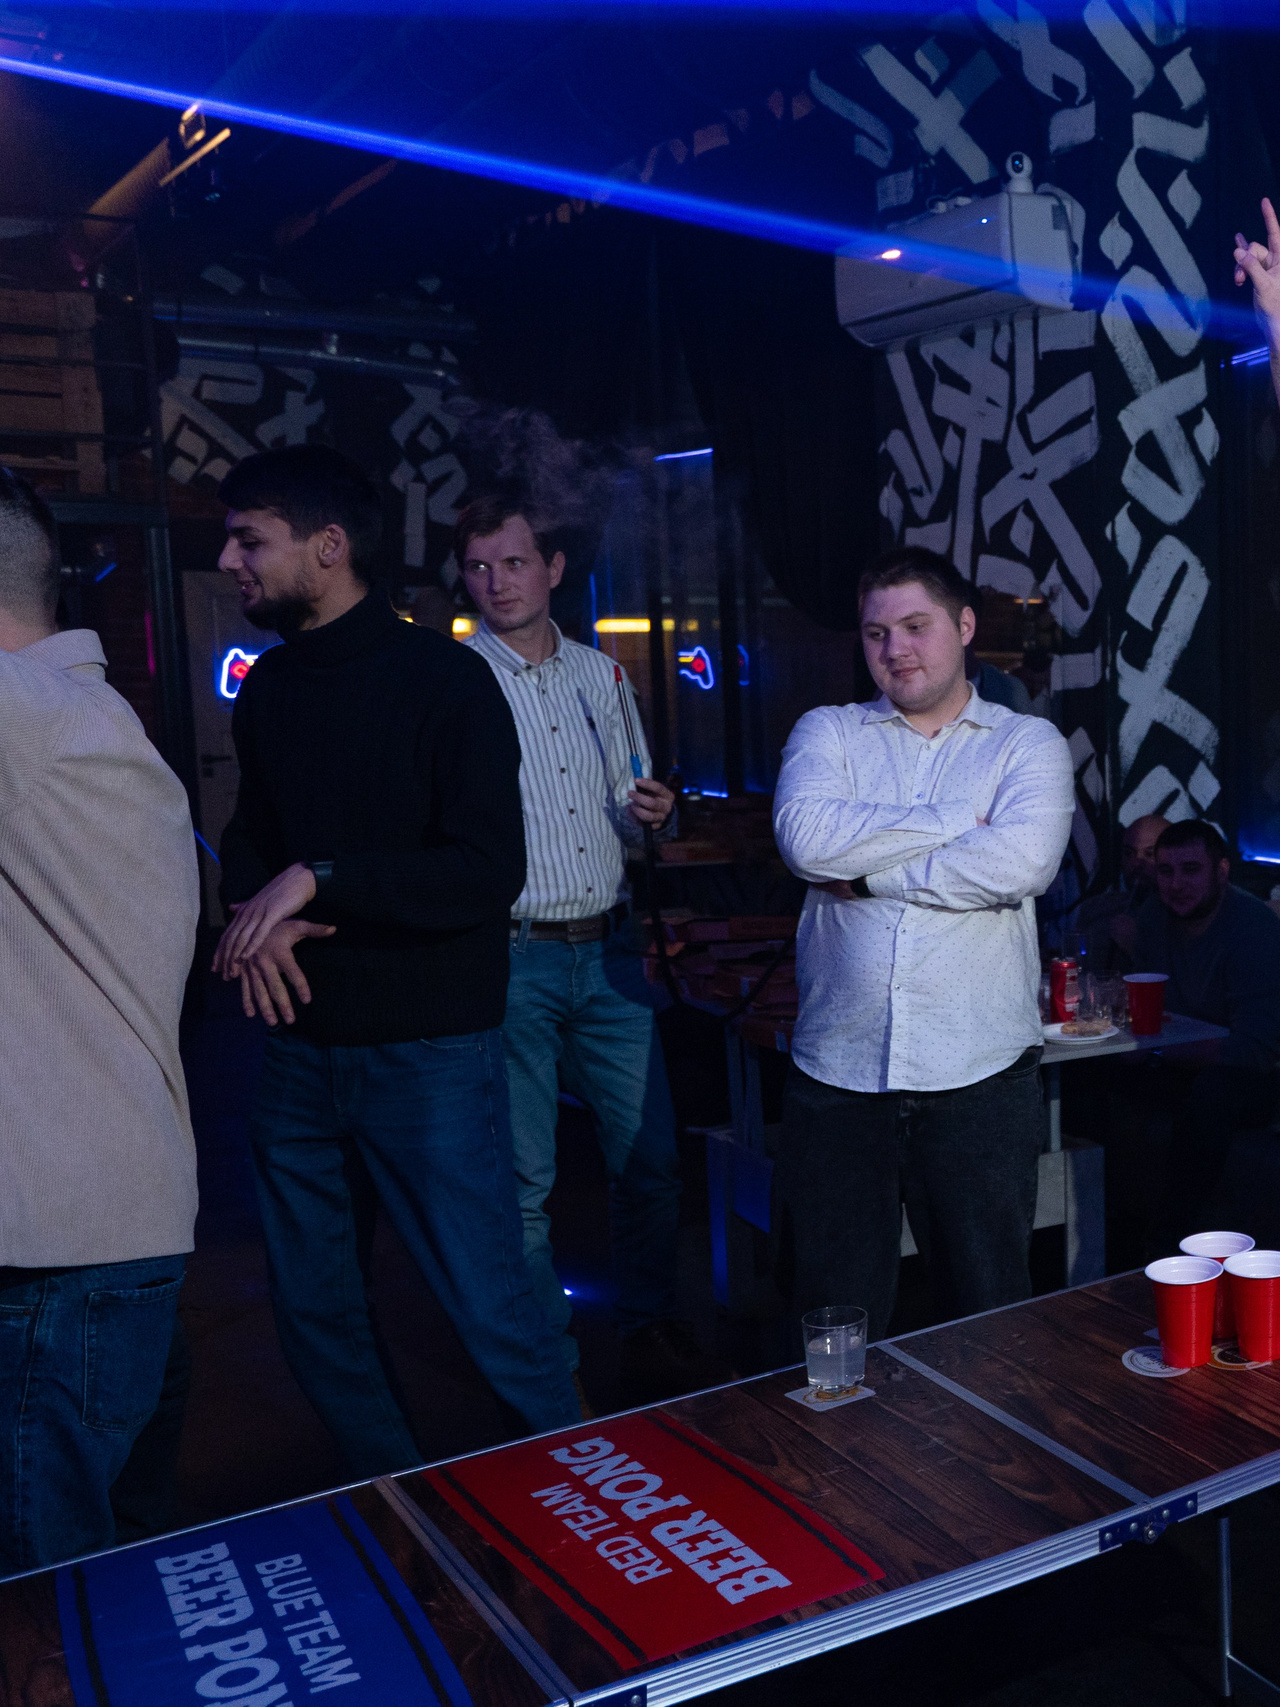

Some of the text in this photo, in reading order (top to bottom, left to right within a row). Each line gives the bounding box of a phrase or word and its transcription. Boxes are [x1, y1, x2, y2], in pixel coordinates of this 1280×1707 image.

[530, 1482, 673, 1585] RED TEAM
[547, 1436, 793, 1605] BEER PONG
[154, 1541, 254, 1640] BEER
[255, 1553, 362, 1694] BLUE TEAM
